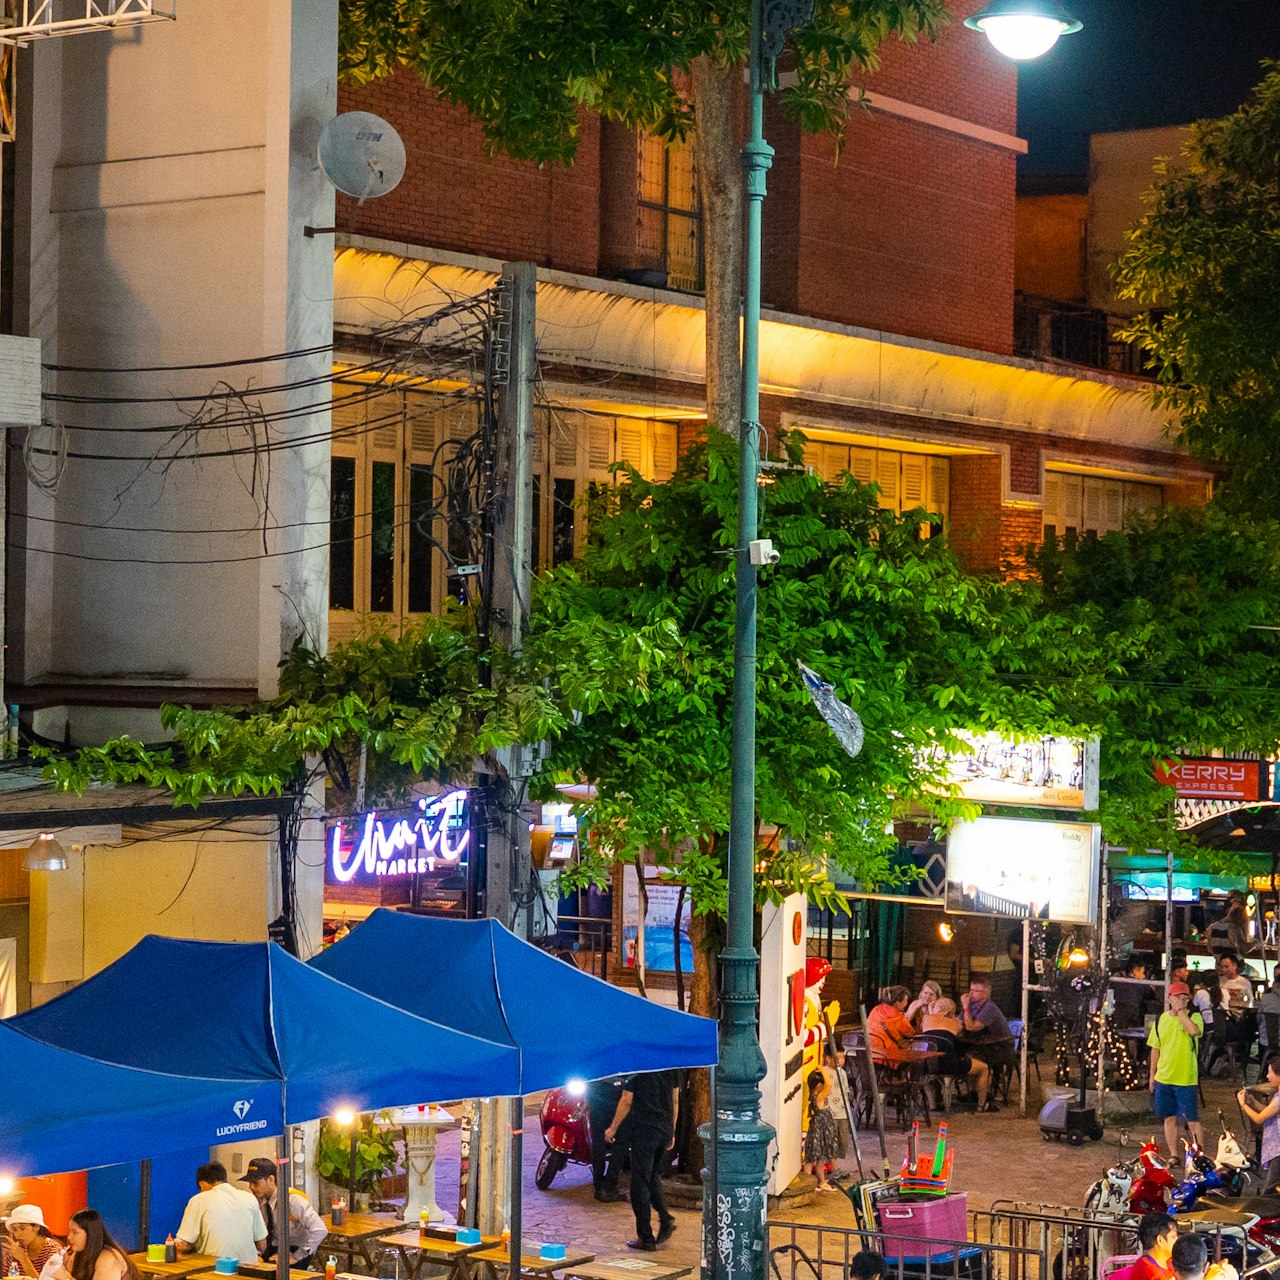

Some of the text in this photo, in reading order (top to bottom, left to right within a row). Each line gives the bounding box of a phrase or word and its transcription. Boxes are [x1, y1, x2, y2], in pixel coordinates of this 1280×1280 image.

[1176, 782, 1235, 791] EXPRESS
[376, 856, 435, 876] MARKET
[216, 1119, 268, 1137] LUCKYFRIEND
